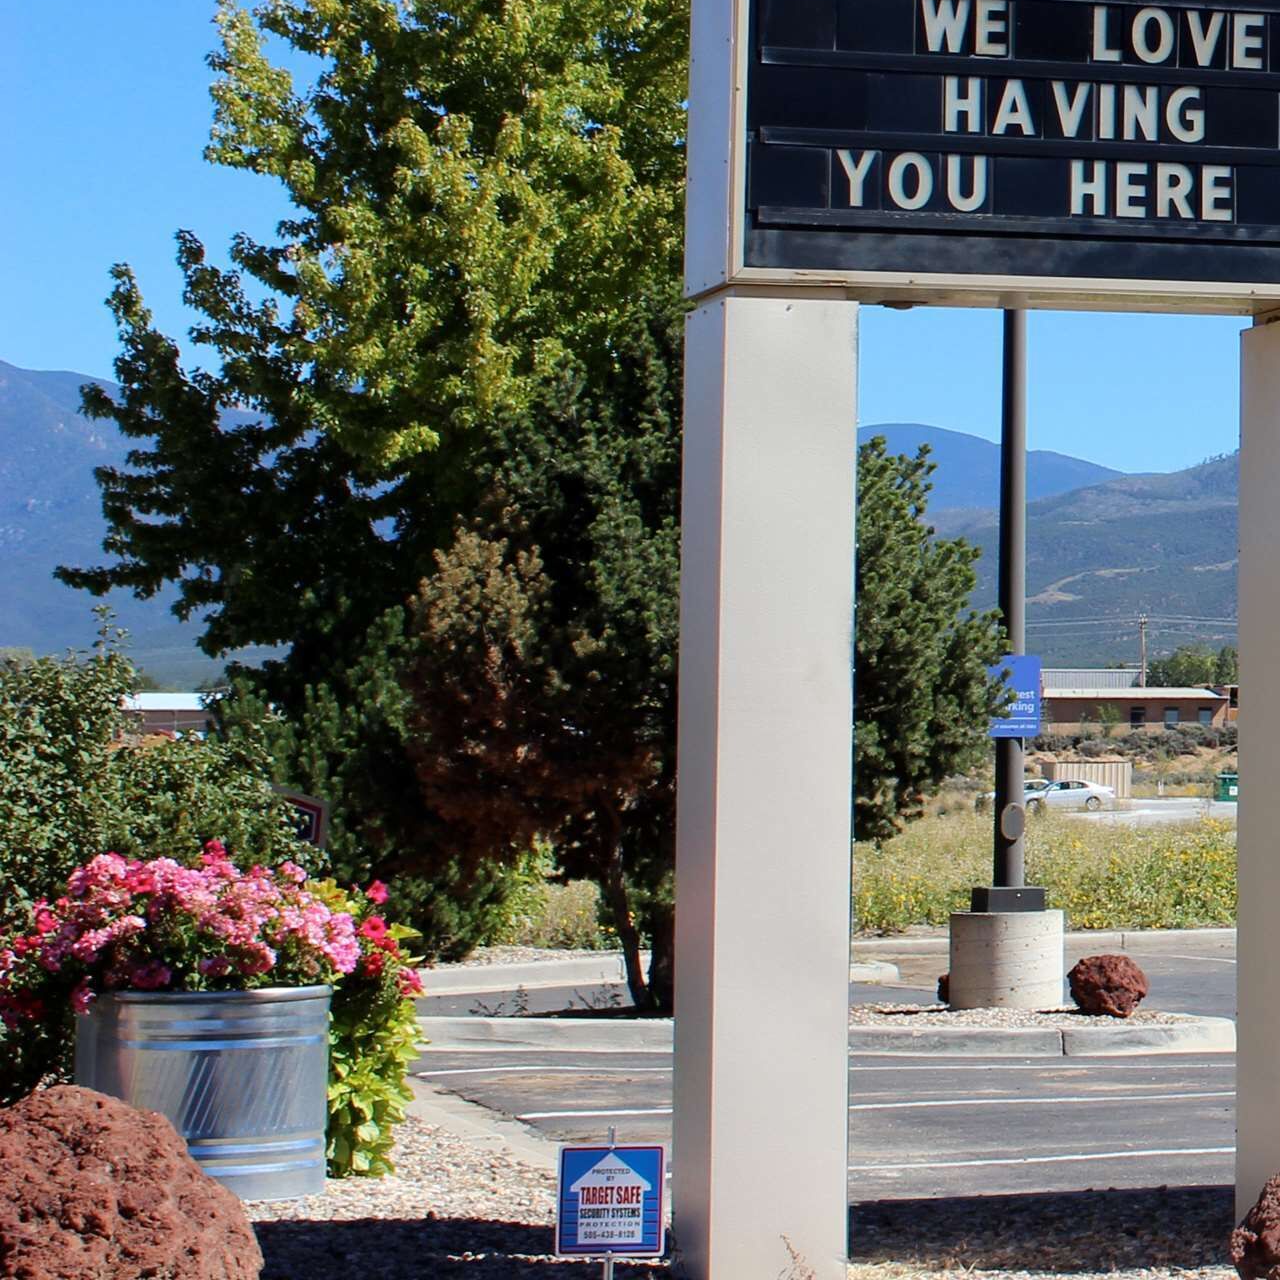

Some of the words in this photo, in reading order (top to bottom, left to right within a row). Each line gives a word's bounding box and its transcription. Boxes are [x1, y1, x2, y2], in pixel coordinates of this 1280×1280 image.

[1093, 6, 1264, 70] LOVE
[944, 76, 1205, 144] HAVING
[837, 149, 987, 212] YOU
[1070, 161, 1233, 222] HERE
[592, 1167, 631, 1175] PROTECTED
[580, 1186, 614, 1205] TARGET
[616, 1186, 641, 1204] SAFE
[580, 1208, 610, 1219] SECURITY
[611, 1207, 640, 1218] SYSTEMS
